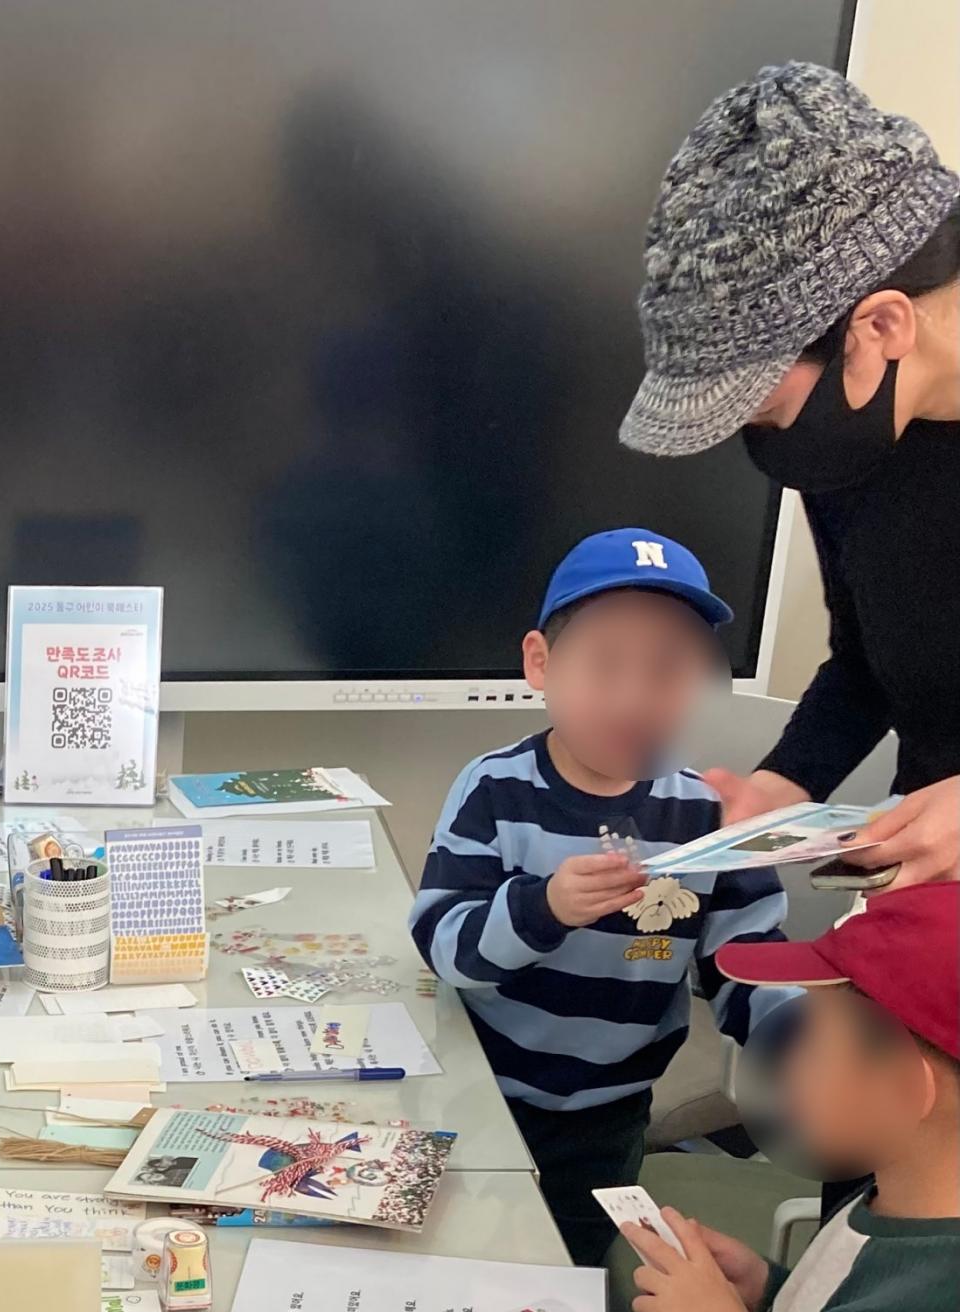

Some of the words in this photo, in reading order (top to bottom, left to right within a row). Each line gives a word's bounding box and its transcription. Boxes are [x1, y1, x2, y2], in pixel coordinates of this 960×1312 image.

[632, 541, 668, 569] N
[57, 665, 110, 679] QR코드
[5, 1190, 33, 1199] You
[290, 1291, 304, 1310] 있어요.
